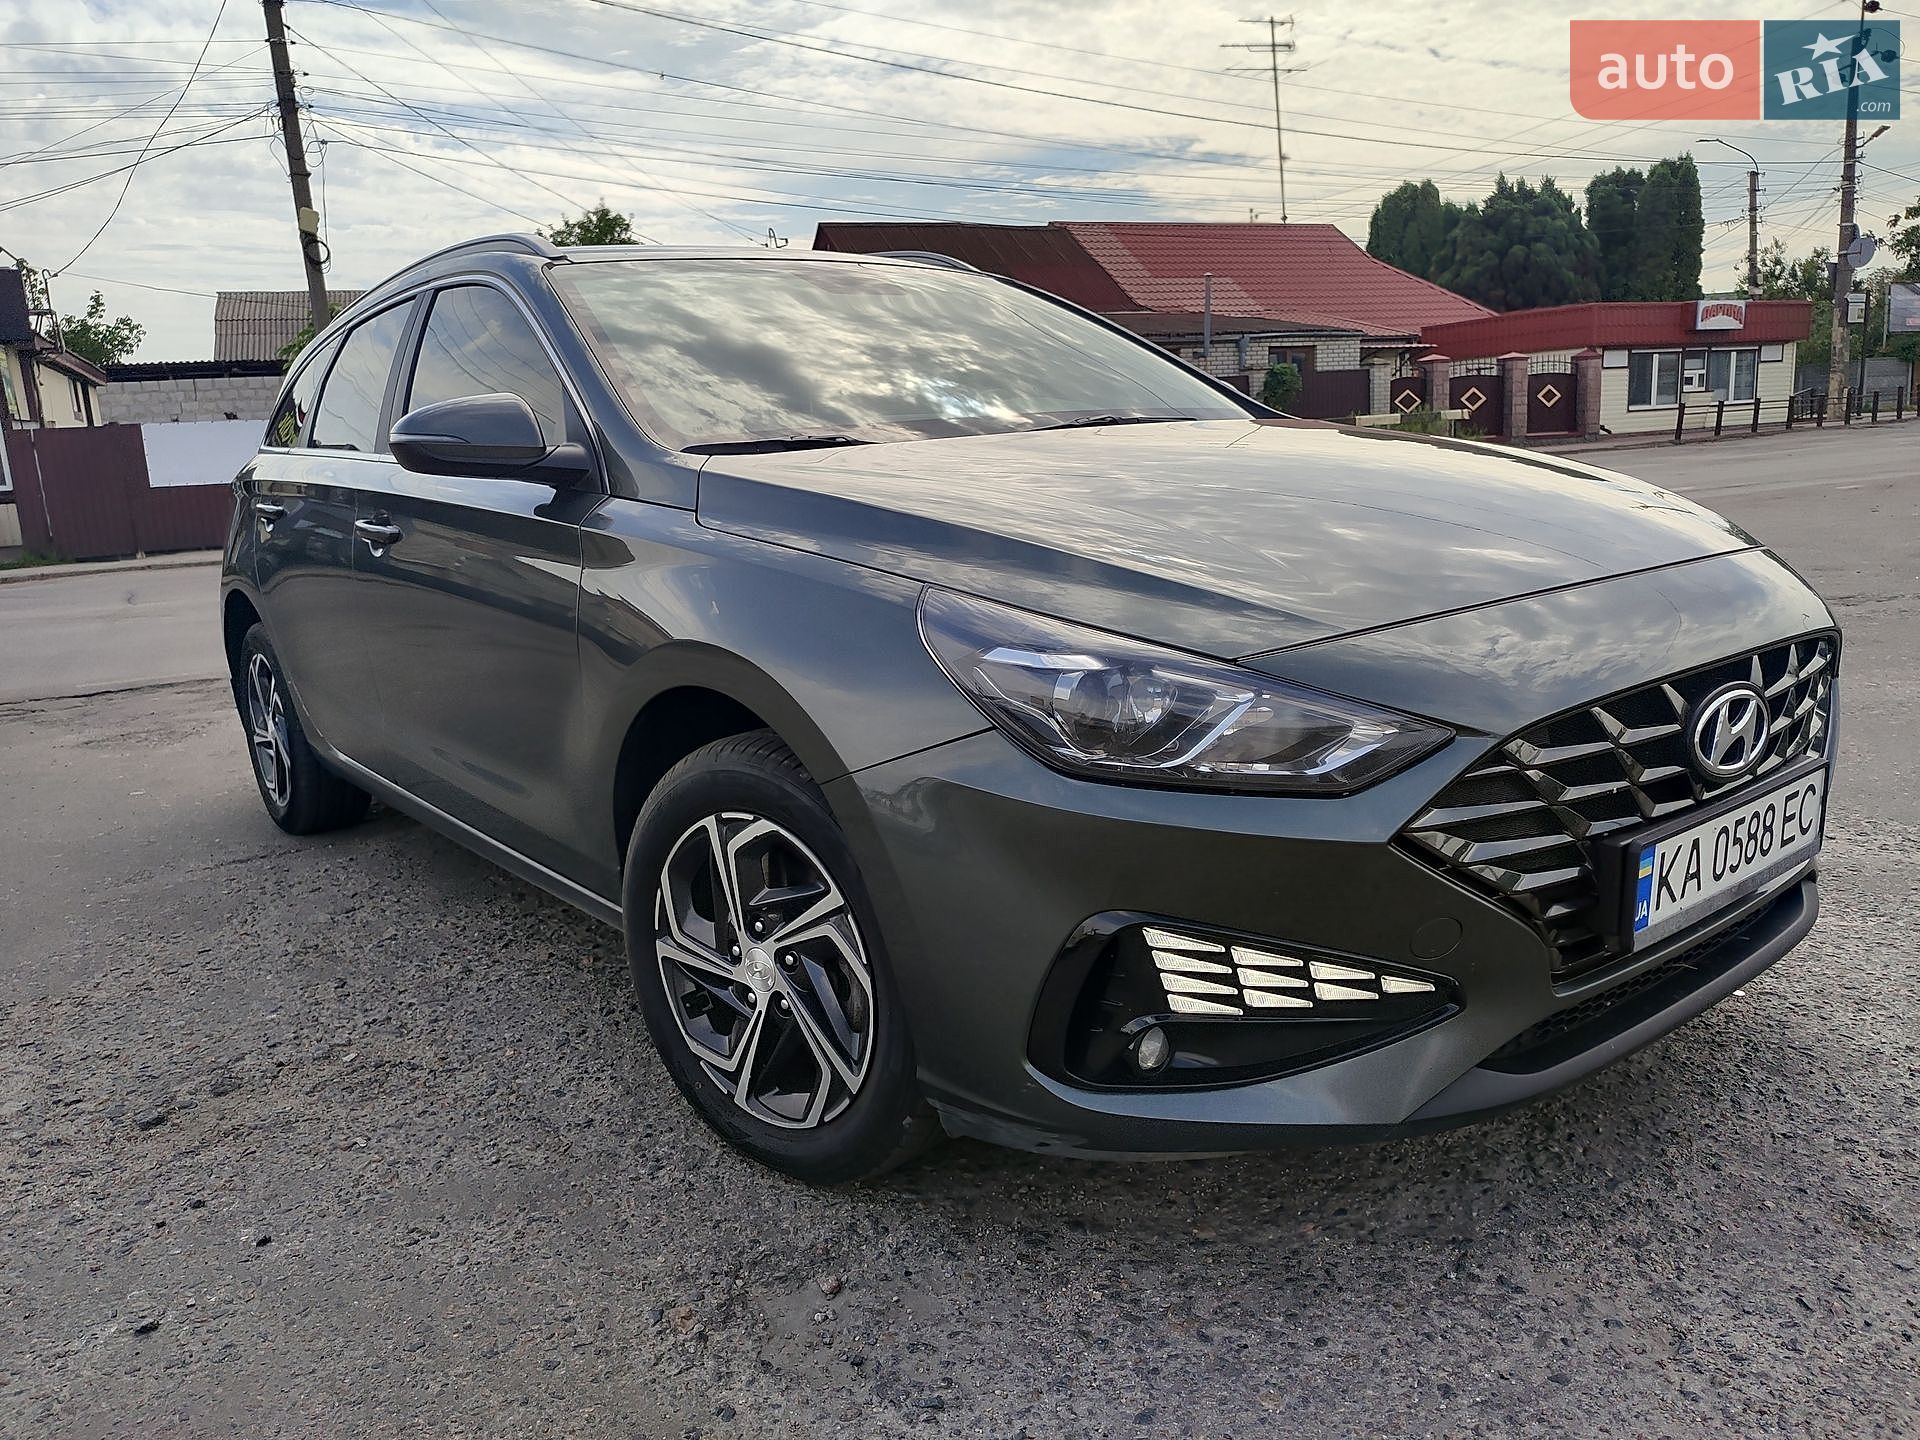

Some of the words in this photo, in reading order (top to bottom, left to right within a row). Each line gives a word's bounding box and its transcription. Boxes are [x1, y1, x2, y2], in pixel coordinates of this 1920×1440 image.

[1655, 837, 1701, 911] KA
[1712, 803, 1776, 882] 0588
[1780, 783, 1817, 849] EC
